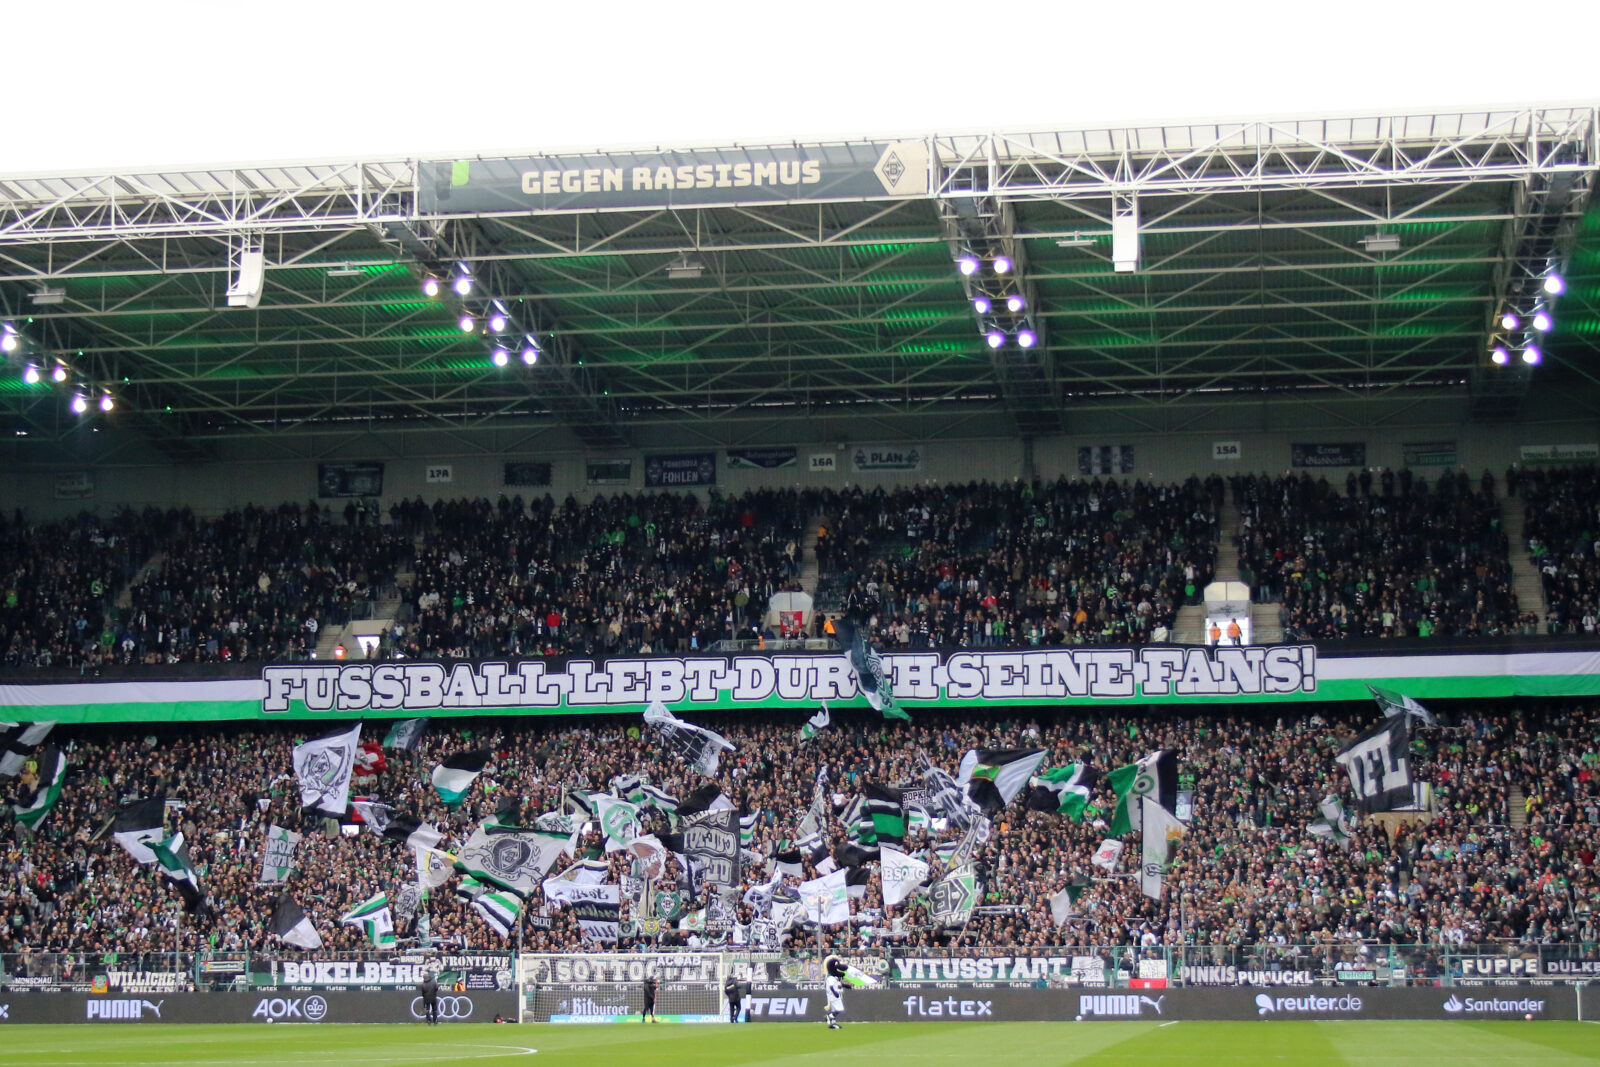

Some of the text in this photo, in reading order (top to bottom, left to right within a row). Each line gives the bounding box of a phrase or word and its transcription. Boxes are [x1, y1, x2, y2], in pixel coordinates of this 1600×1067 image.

[521, 159, 822, 195] GEGEN RASSISMUS
[871, 452, 903, 462] PLAN
[1216, 445, 1237, 455] 15A
[811, 457, 833, 467] 16A
[429, 468, 449, 478] 17A
[263, 661, 561, 712] FUSSBALL
[566, 656, 731, 707] LEBT
[731, 652, 941, 703] DURH
[945, 647, 1136, 699] SEINE
[1140, 644, 1317, 697] FANS!
[441, 956, 510, 968] FRONTLINE
[894, 957, 1067, 979] VITUSSTADT
[1461, 958, 1538, 974] FUPPE
[108, 971, 187, 987] WILLICHER
[283, 960, 426, 984] BÖKELBERG
[1181, 965, 1236, 983] PINKIS
[1237, 970, 1314, 985] PUMUCKL
[570, 984, 598, 992] flatex
[87, 999, 142, 1019] PUMA
[253, 998, 302, 1018] AOK
[572, 997, 630, 1016] Bitburger
[902, 995, 993, 1017] flatex
[1079, 995, 1141, 1016] PUMA
[1276, 993, 1362, 1012] reuter.de
[1464, 998, 1545, 1013] Santander
[570, 1014, 605, 1023] JONGEN
